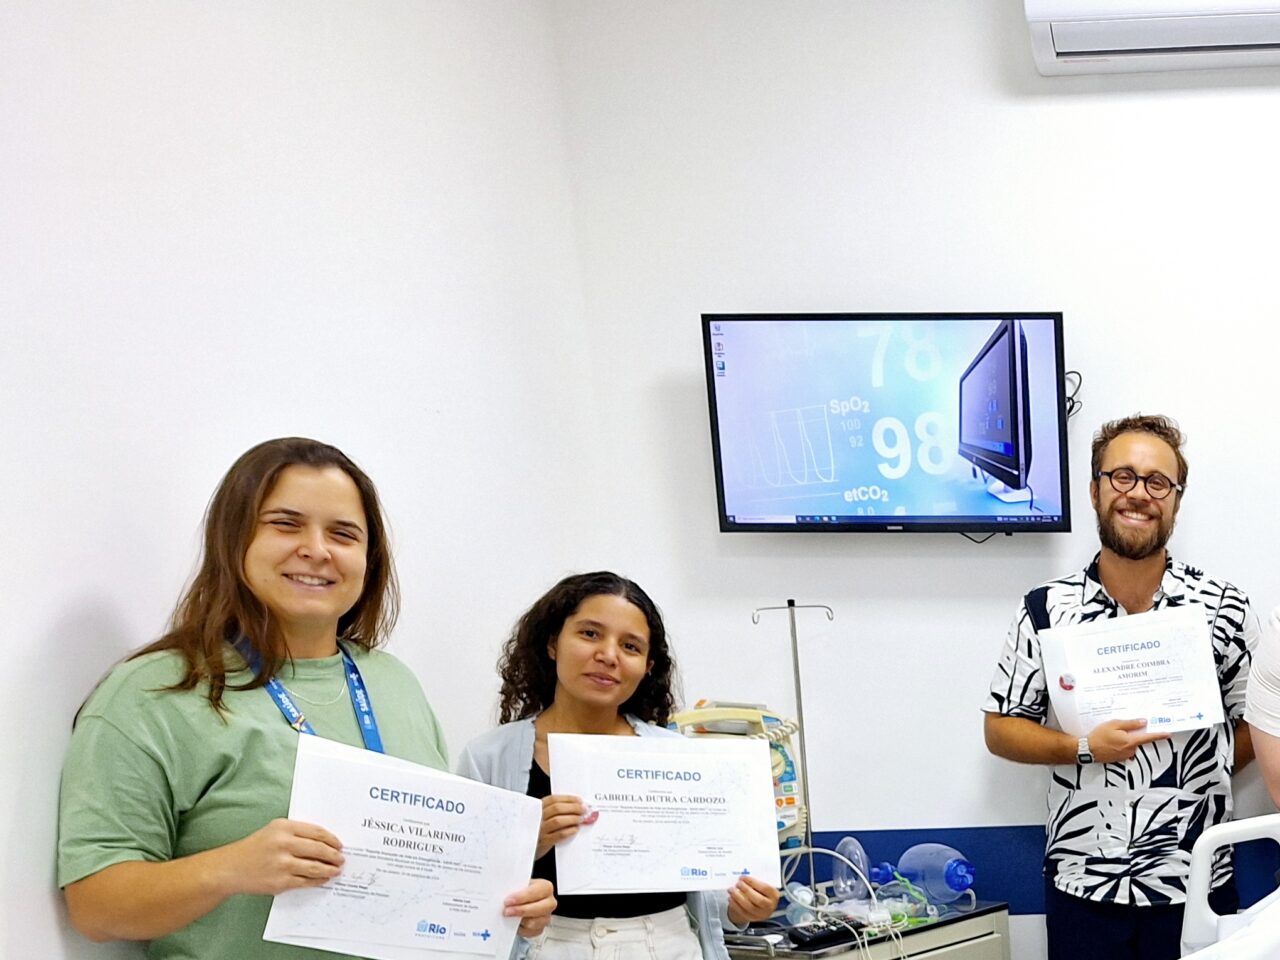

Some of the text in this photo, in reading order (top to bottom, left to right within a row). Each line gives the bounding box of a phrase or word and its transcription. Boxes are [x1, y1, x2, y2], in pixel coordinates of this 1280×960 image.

[839, 418, 861, 432] 100
[849, 435, 863, 448] 92
[871, 411, 952, 480] 98
[1097, 640, 1161, 656] CERTIFICADO
[1092, 659, 1171, 674] ALEXANDRE COIMBRA
[1117, 671, 1148, 680] AMORIM
[617, 768, 702, 782] CERTIFICADO
[369, 786, 465, 815] CERTIFICADO
[594, 793, 726, 805] GABRIELA DUTRA CARDOZO
[361, 816, 405, 835] JÉSSICA
[408, 826, 466, 844] VILARINHO
[382, 836, 445, 854] RODRIGUES
[691, 868, 708, 877] Rio
[428, 923, 447, 935] Rio
